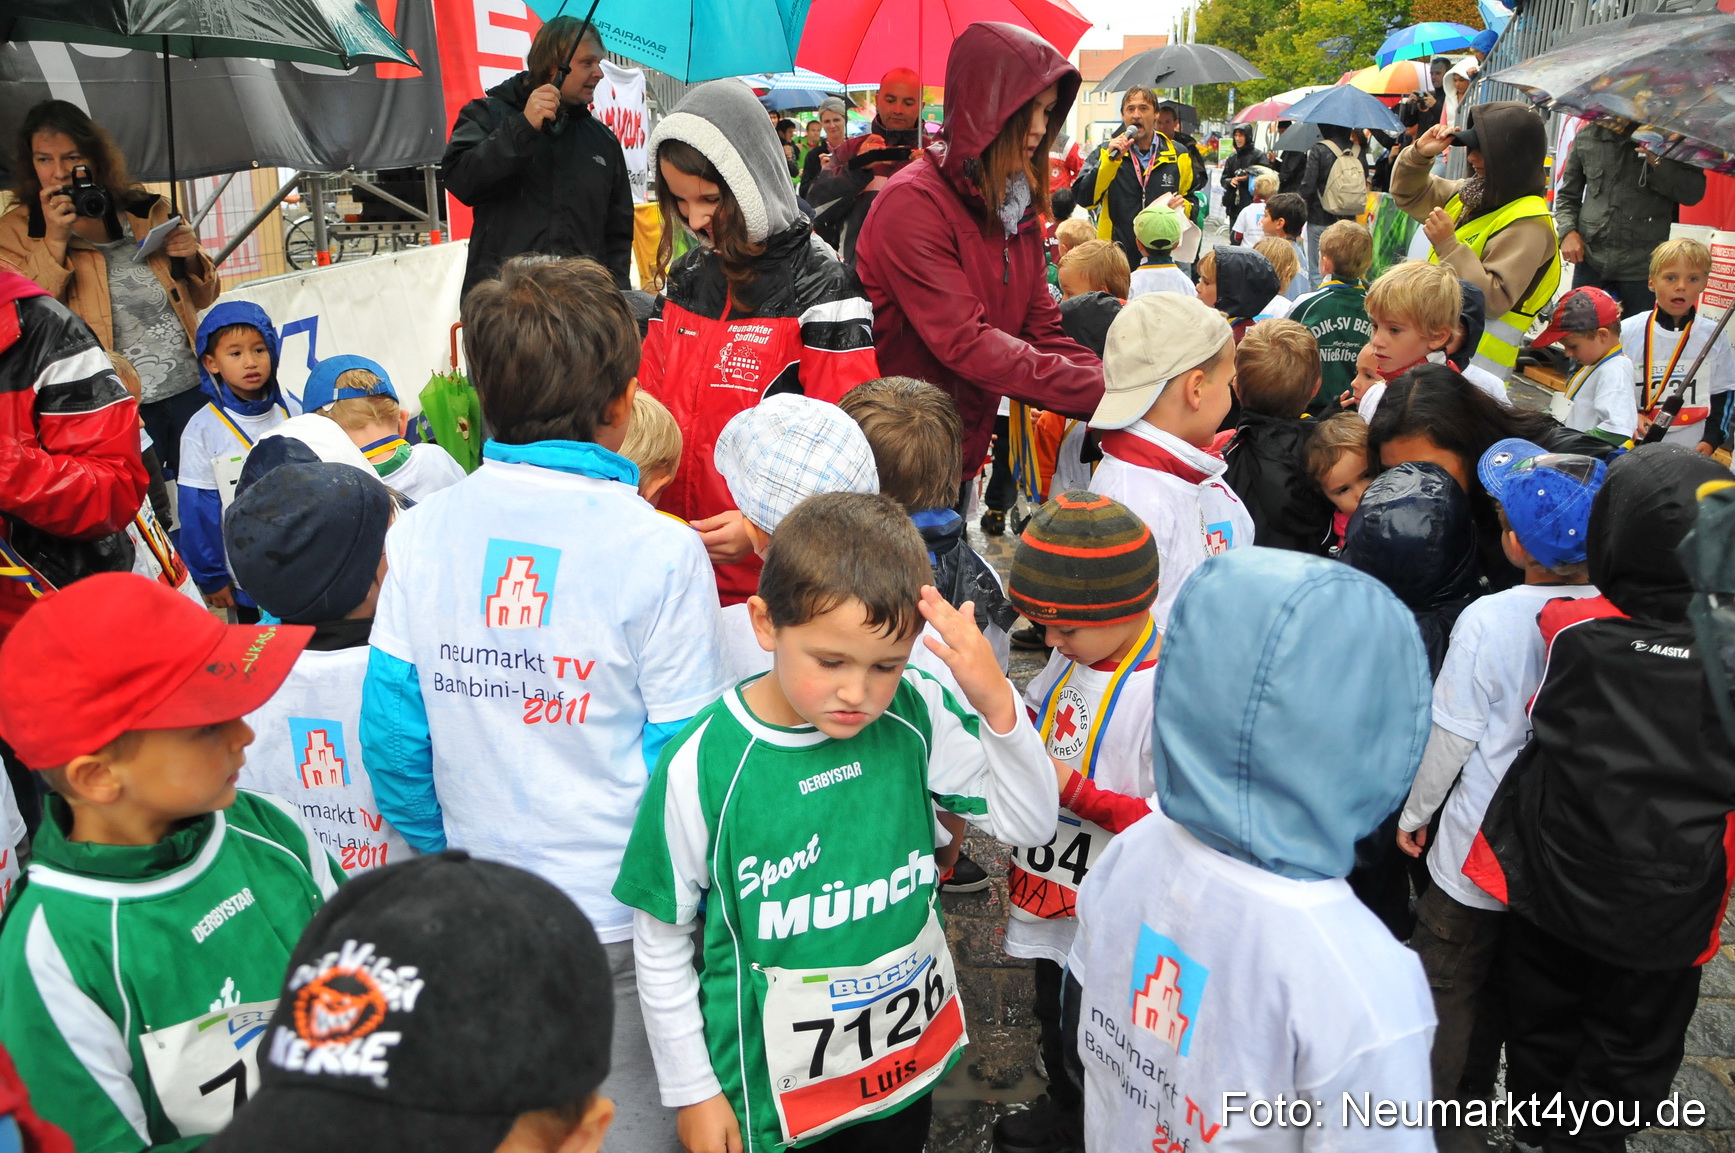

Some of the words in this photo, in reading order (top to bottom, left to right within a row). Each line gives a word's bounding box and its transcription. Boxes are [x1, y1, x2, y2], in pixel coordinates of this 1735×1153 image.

[1310, 317, 1351, 339] DJK-SV
[1353, 318, 1374, 339] BER
[1319, 348, 1358, 363] Nießlbe
[440, 643, 546, 675] neumarkt
[552, 656, 596, 681] TV
[1648, 644, 1691, 660] MASITA
[434, 671, 565, 709] Bambini-Lauf
[522, 691, 591, 726] 2011
[1053, 737, 1084, 757] KREUZ
[797, 761, 863, 796] DERBYSTAR
[287, 800, 357, 825] markt
[359, 807, 383, 832] TV
[340, 841, 389, 871] 2011
[737, 833, 822, 900] Sport
[1012, 830, 1090, 887] 84
[190, 887, 256, 944] DERBYSTAR
[829, 950, 918, 998] BOCK
[792, 957, 945, 1080] 7126
[860, 1059, 917, 1099] Luis
[1091, 1006, 1178, 1109] neumarkt
[1184, 1095, 1222, 1144] TV
